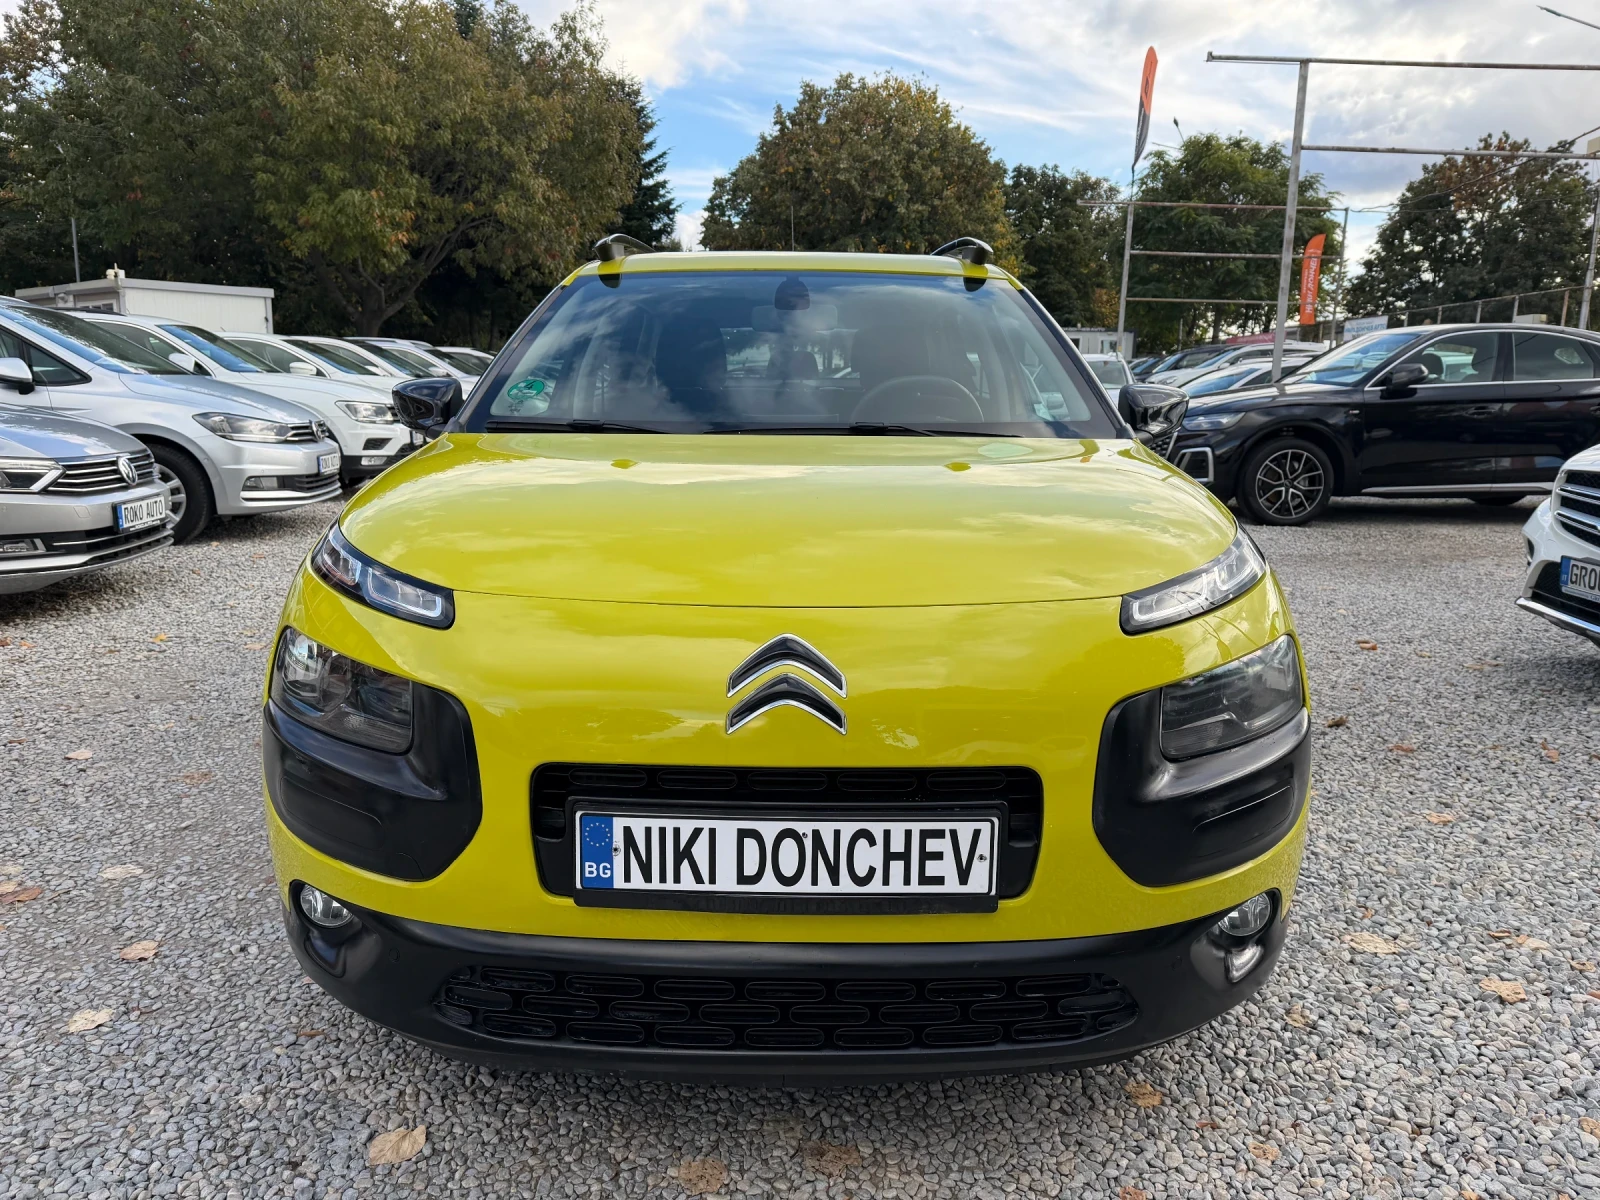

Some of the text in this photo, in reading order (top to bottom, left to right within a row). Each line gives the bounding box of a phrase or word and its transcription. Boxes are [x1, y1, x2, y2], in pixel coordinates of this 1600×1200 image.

[124, 504, 144, 525] ROKO
[146, 499, 164, 519] AUTO
[1570, 563, 1600, 592] GRO
[623, 825, 982, 887] NIKI DONCHEV
[585, 862, 611, 878] BG
